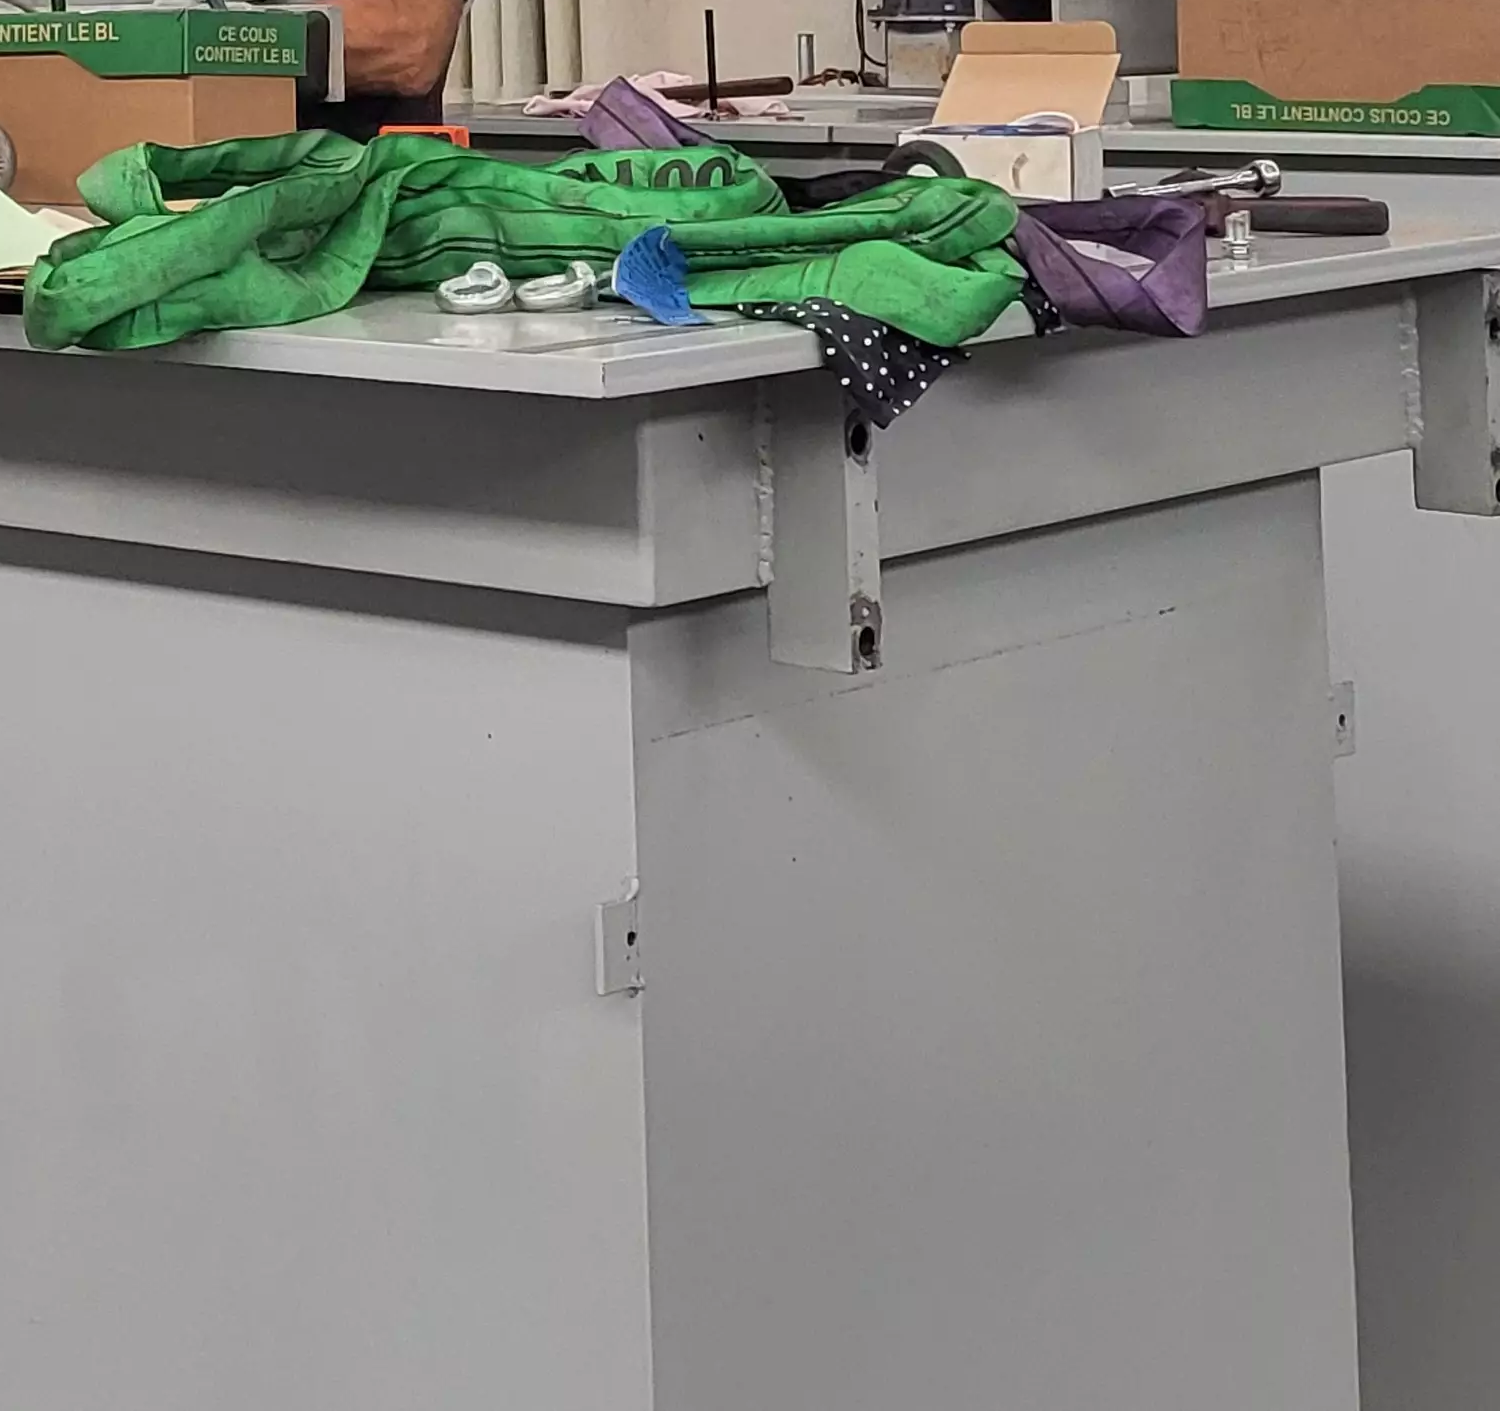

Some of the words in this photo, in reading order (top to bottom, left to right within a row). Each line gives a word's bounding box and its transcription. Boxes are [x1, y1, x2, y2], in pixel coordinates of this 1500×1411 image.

[67, 22, 90, 41] LE
[95, 22, 120, 41] BL
[218, 26, 237, 42] CE
[239, 27, 278, 43] COLIS
[195, 46, 260, 64] CONTIENT
[263, 47, 280, 64] LE
[282, 49, 299, 64] BL
[1230, 103, 1252, 119] BL
[1256, 104, 1276, 120] LE
[1280, 105, 1365, 123] CONTIENT
[1369, 108, 1421, 125] COLIS
[1425, 109, 1451, 126] CE
